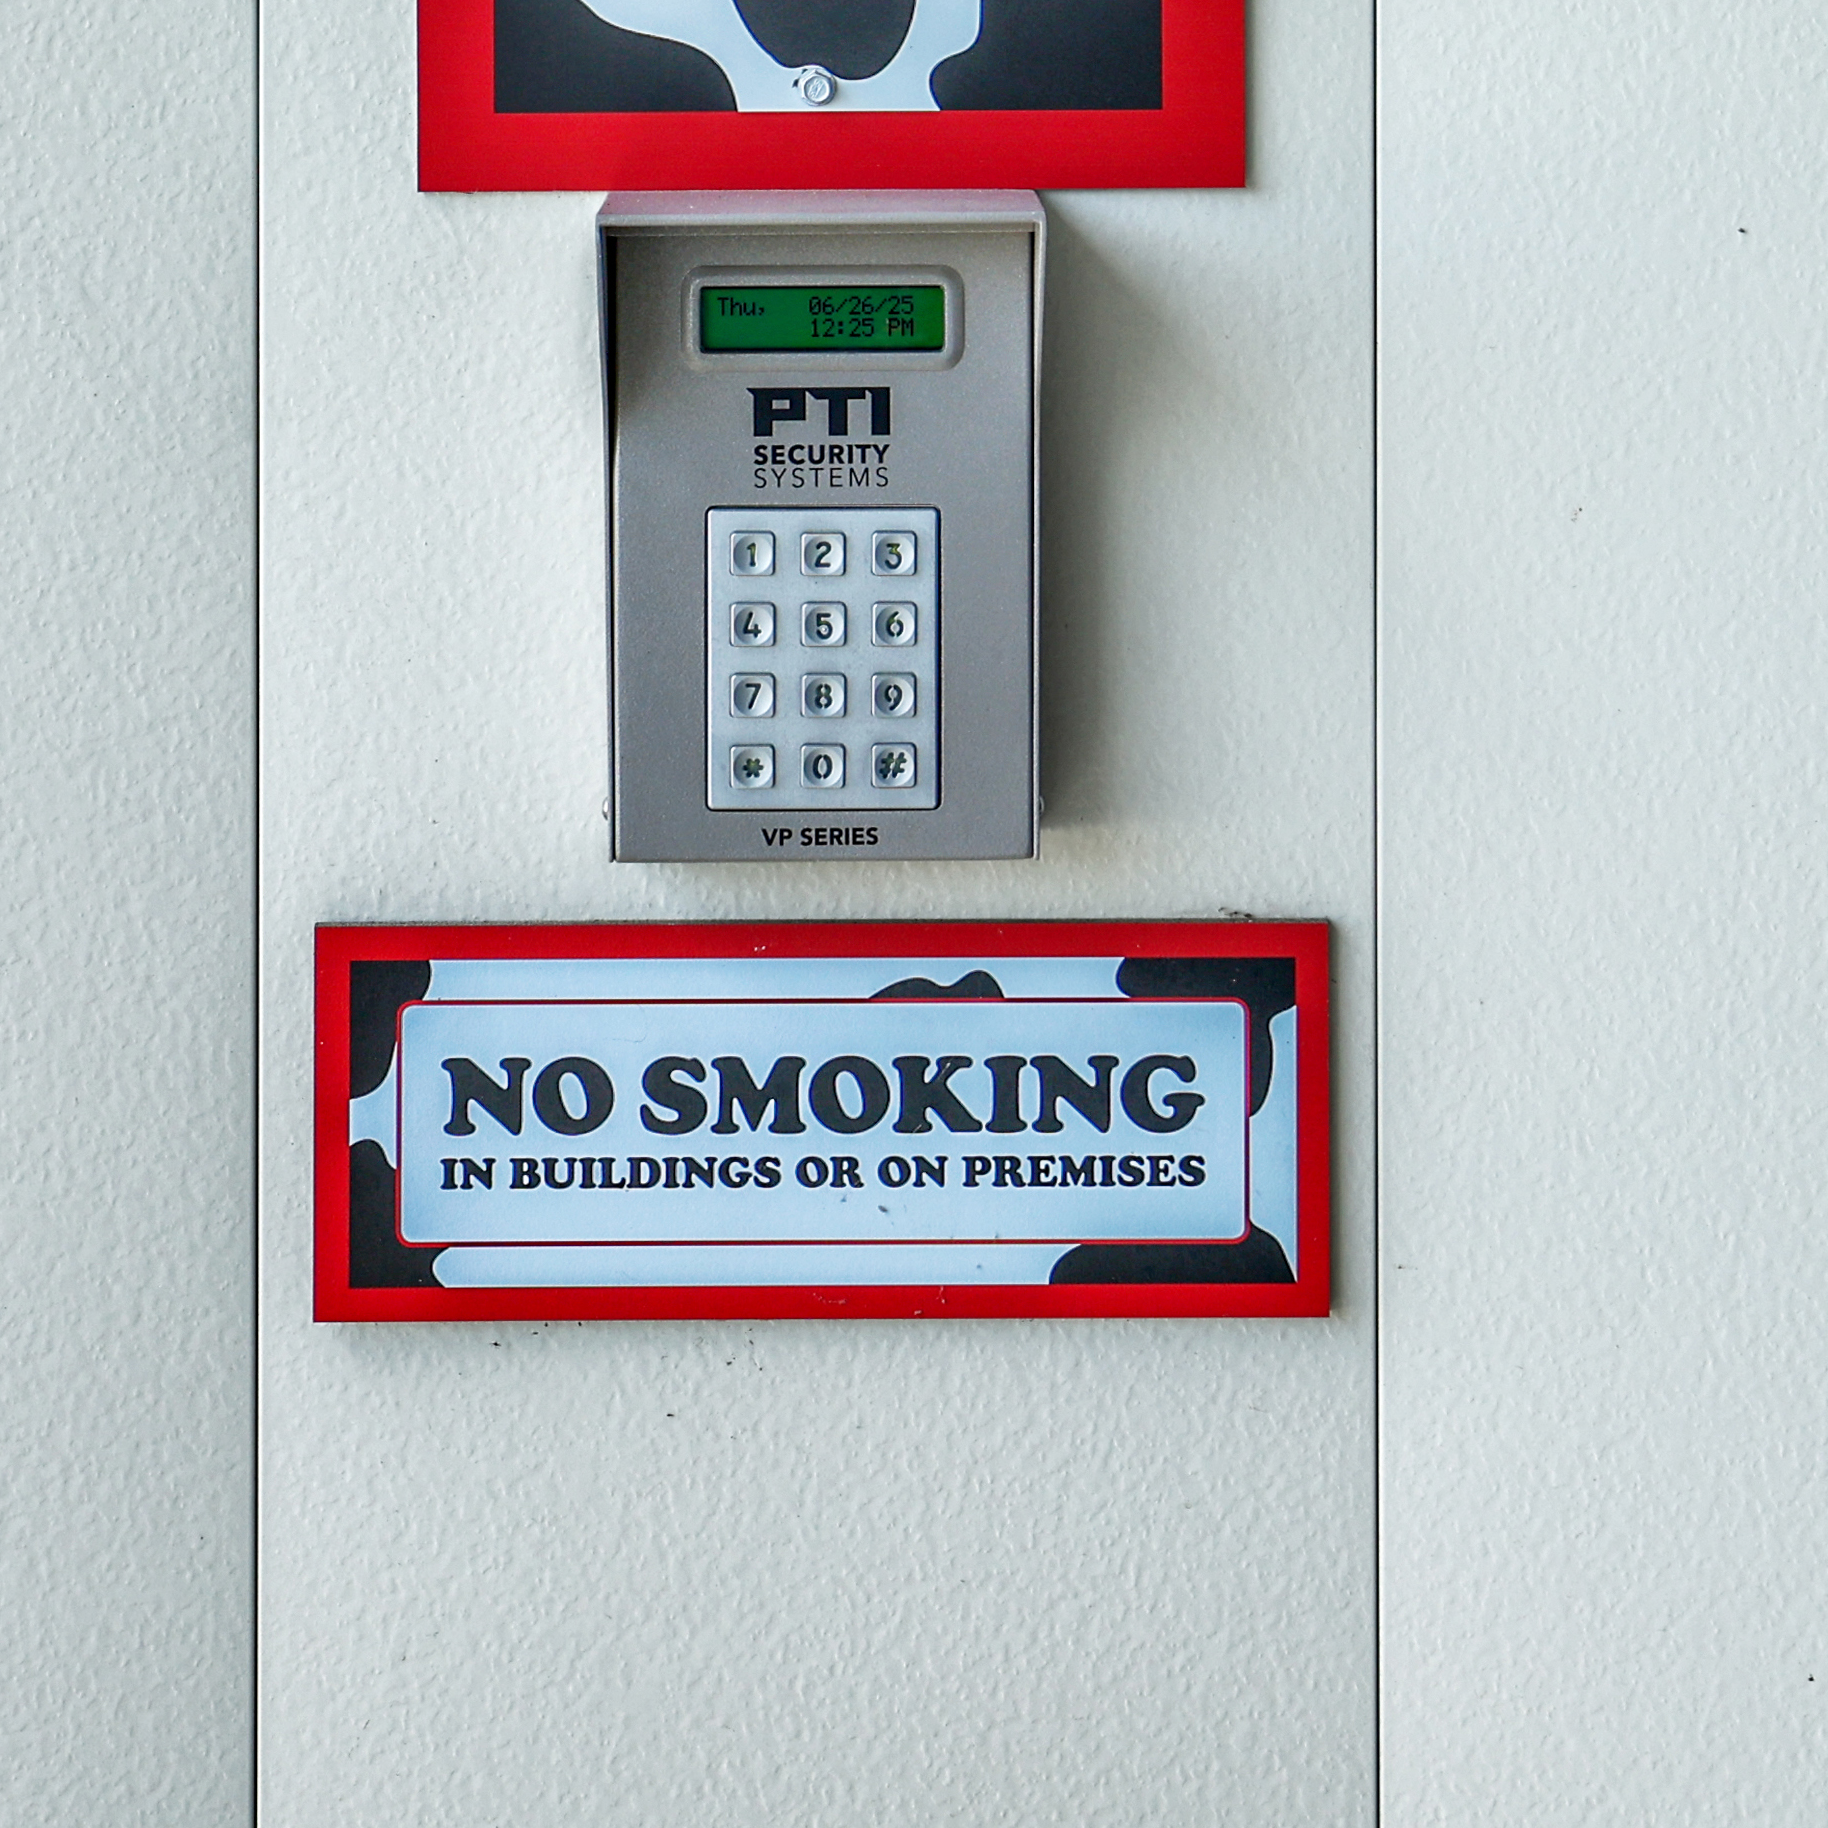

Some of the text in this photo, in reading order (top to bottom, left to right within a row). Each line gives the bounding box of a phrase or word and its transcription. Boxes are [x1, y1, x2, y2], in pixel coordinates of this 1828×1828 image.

[717, 295, 914, 317] Thu, 06/26/25
[810, 317, 914, 337] 12:25 PM
[745, 386, 891, 437] PTI
[753, 443, 890, 466] SECURITY
[754, 466, 889, 489] SYSTEMS
[746, 541, 903, 570] 1 2 3
[743, 611, 904, 640] 4 5 6
[744, 682, 903, 711] 7 8 9
[812, 754, 833, 780] 0
[879, 751, 908, 780] #
[761, 826, 879, 847] VP SERIES
[440, 1054, 1206, 1137] NO SMOKING
[439, 1154, 1206, 1191] IN BUILDINGS OR ON PREMISES
